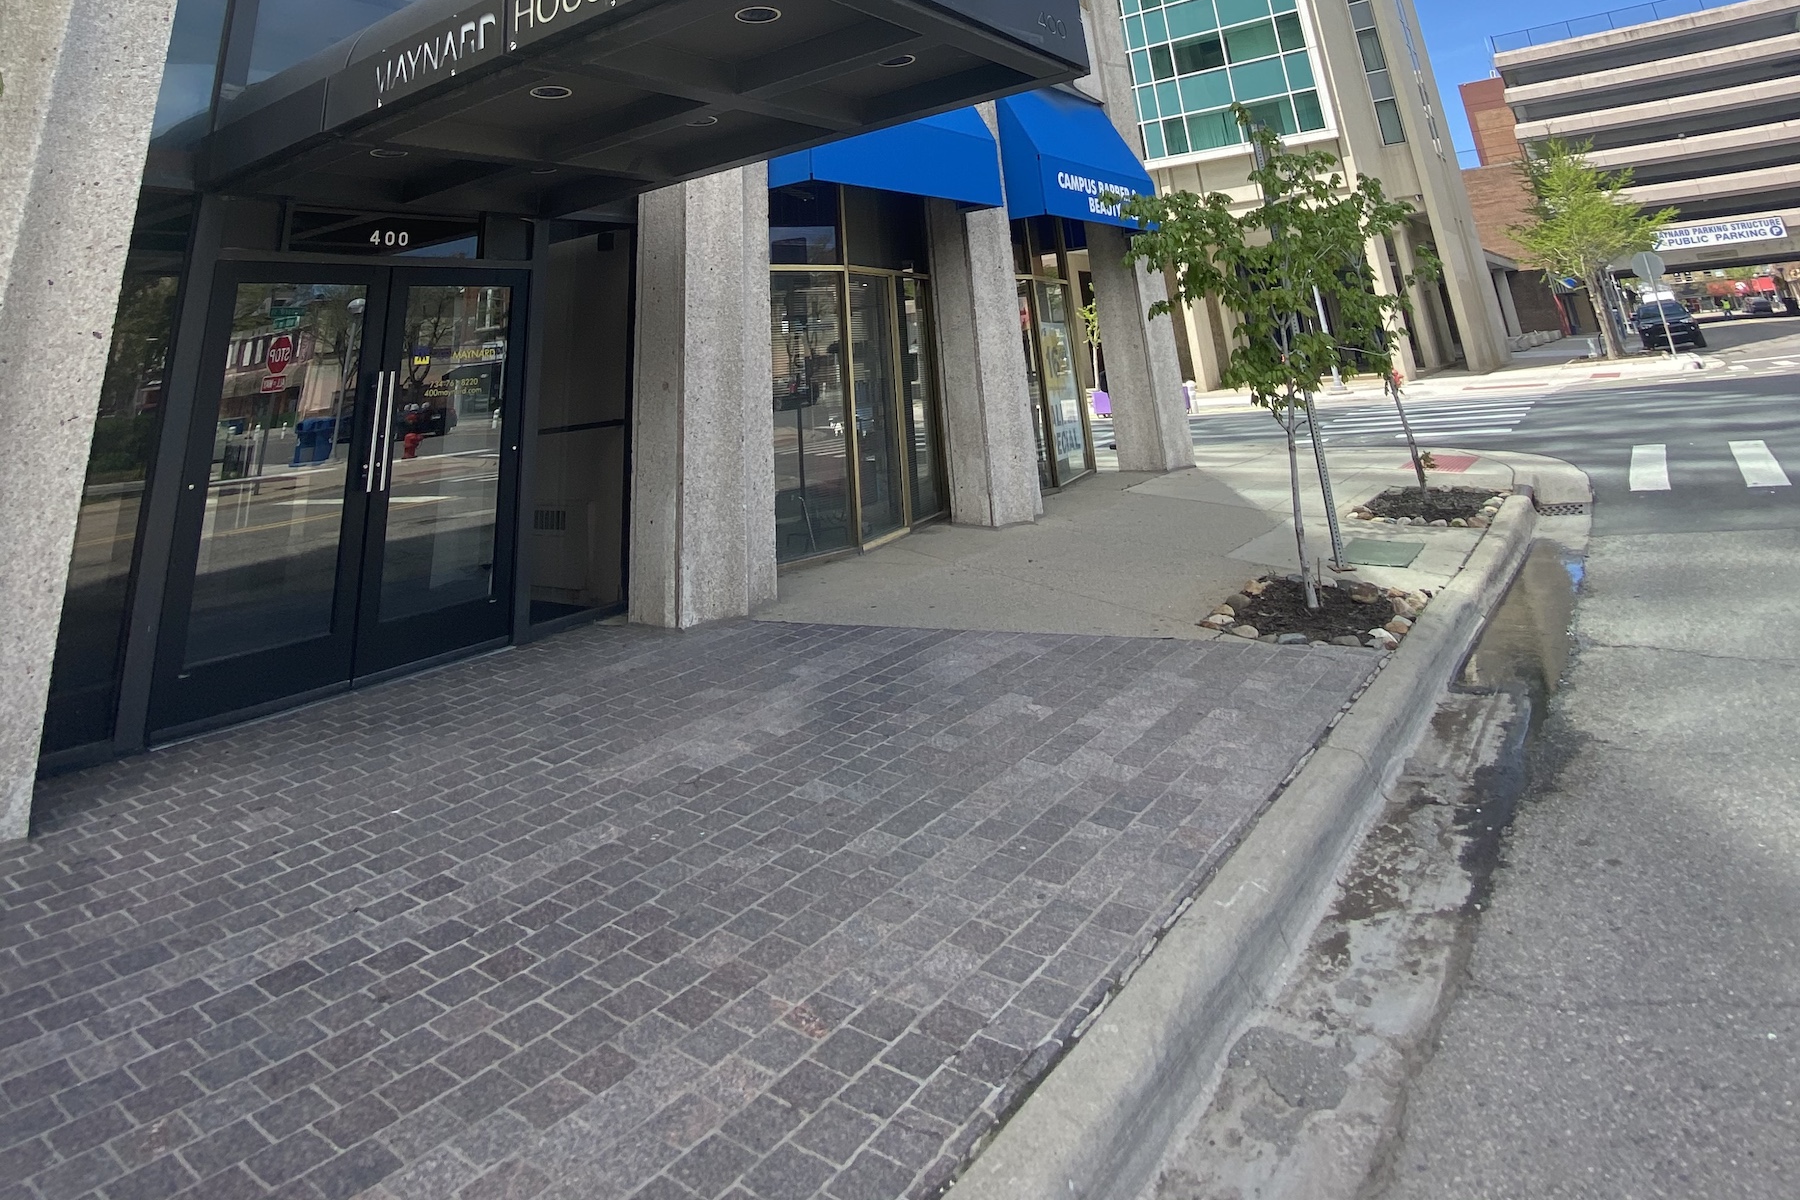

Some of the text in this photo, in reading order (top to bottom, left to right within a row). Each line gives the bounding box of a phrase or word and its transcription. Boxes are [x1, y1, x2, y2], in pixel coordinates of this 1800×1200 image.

[1037, 11, 1067, 40] 400
[1057, 171, 1098, 196] CAMPUS
[1692, 224, 1729, 236] PARKING
[1730, 217, 1781, 232] STRUCTURE
[369, 229, 409, 247] 400
[1668, 235, 1709, 247] PUBLIC
[1715, 228, 1768, 242] PARKING
[452, 348, 496, 360] MAYNARD
